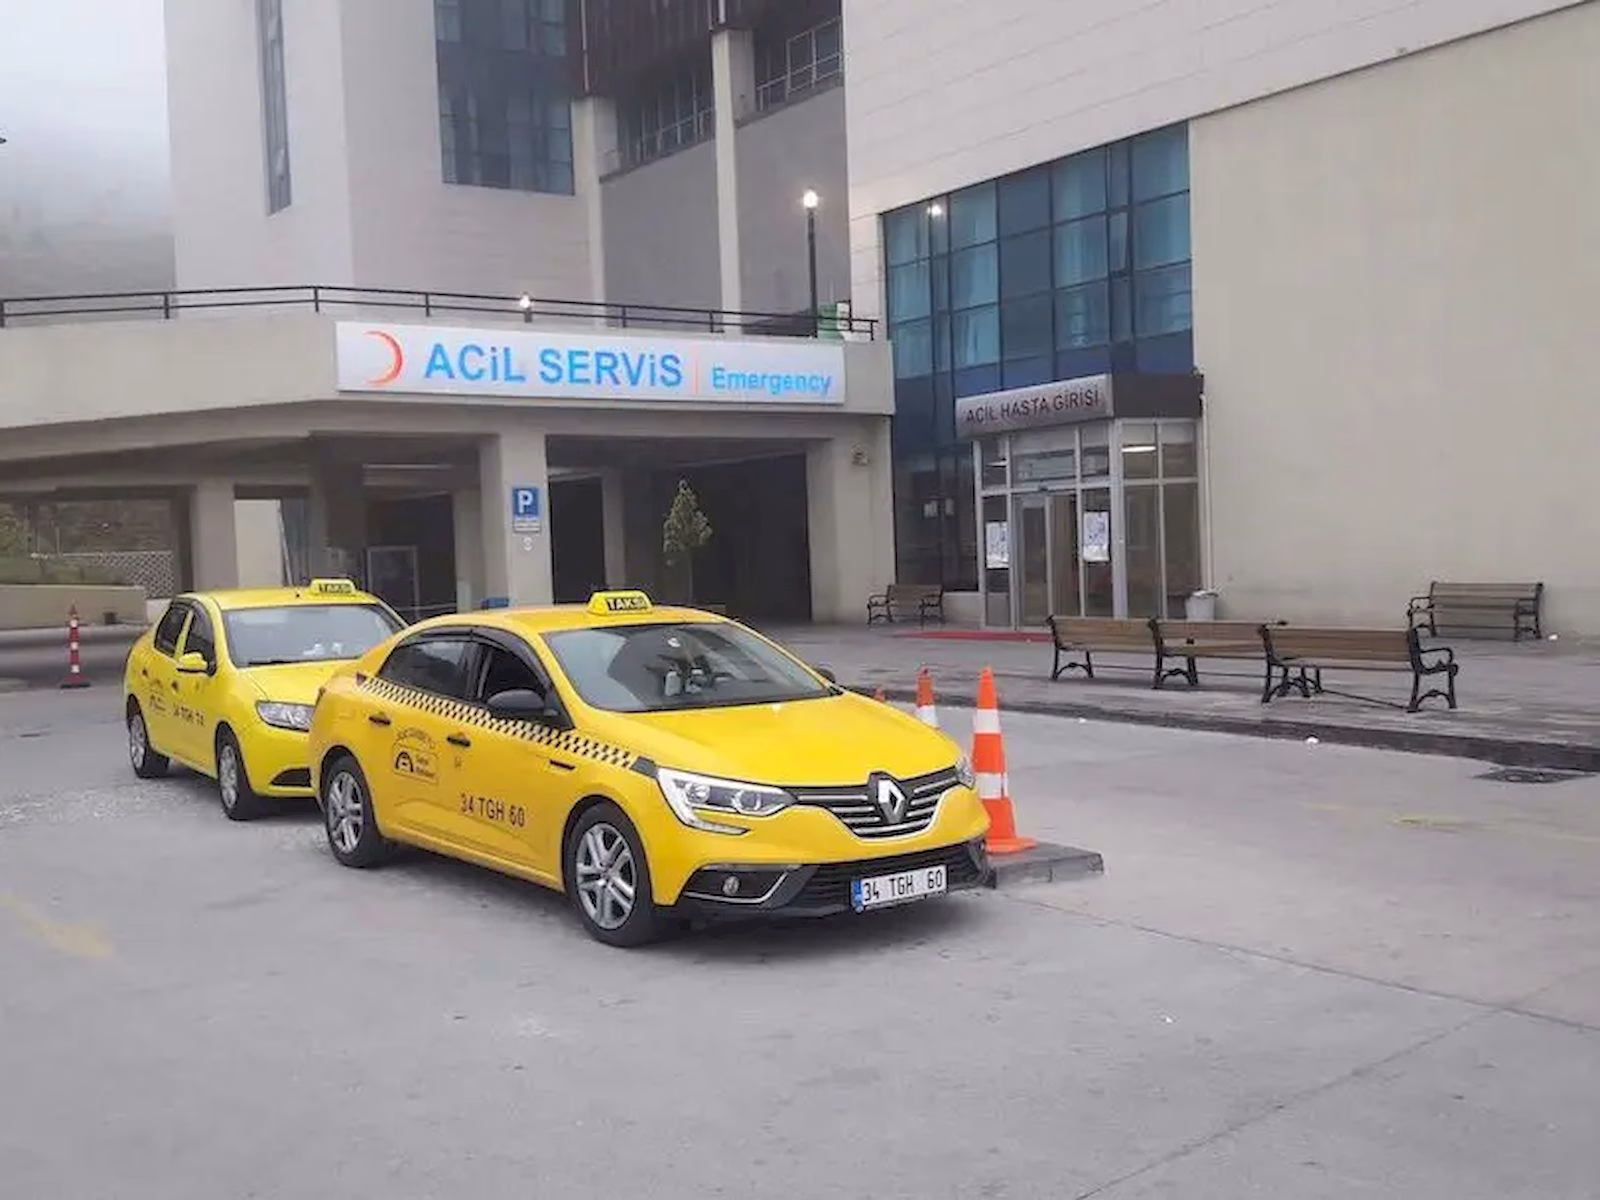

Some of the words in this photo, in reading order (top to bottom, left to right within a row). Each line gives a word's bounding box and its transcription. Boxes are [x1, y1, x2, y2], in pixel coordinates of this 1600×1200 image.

[711, 367, 832, 398] Emergency
[1001, 397, 1050, 418] HASTA
[517, 489, 534, 514] P
[460, 792, 474, 814] 34
[478, 797, 505, 822] TGH
[863, 881, 880, 902] 34
[889, 875, 914, 897] TGH
[927, 869, 943, 890] 60
